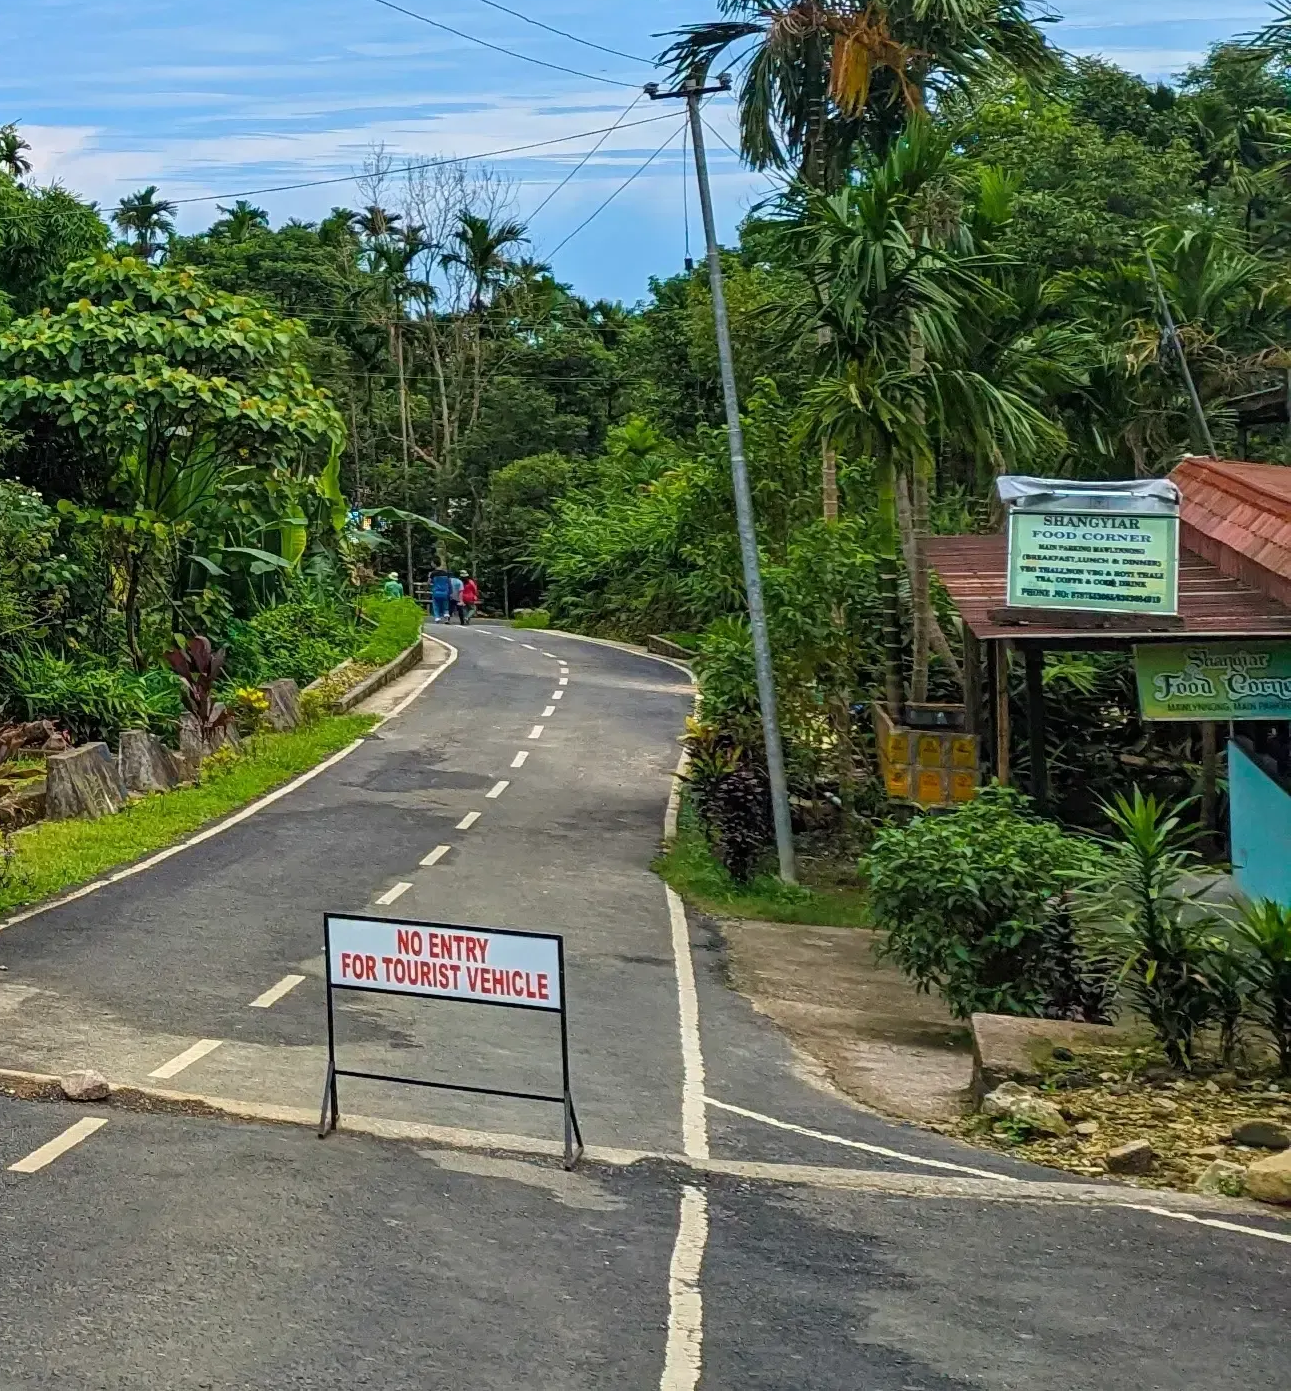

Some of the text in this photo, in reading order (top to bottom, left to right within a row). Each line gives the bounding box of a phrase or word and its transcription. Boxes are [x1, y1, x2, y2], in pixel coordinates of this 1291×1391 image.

[1043, 515, 1141, 530] SHANGYIAR
[1032, 530, 1153, 543] FOOD CORNER
[1019, 565, 1037, 573] VEG
[1086, 569, 1104, 577] VEG
[1156, 673, 1215, 699] Food
[396, 928, 489, 964] NO ENTRY
[341, 951, 550, 1001] FOR TOURIST VEHICLE
